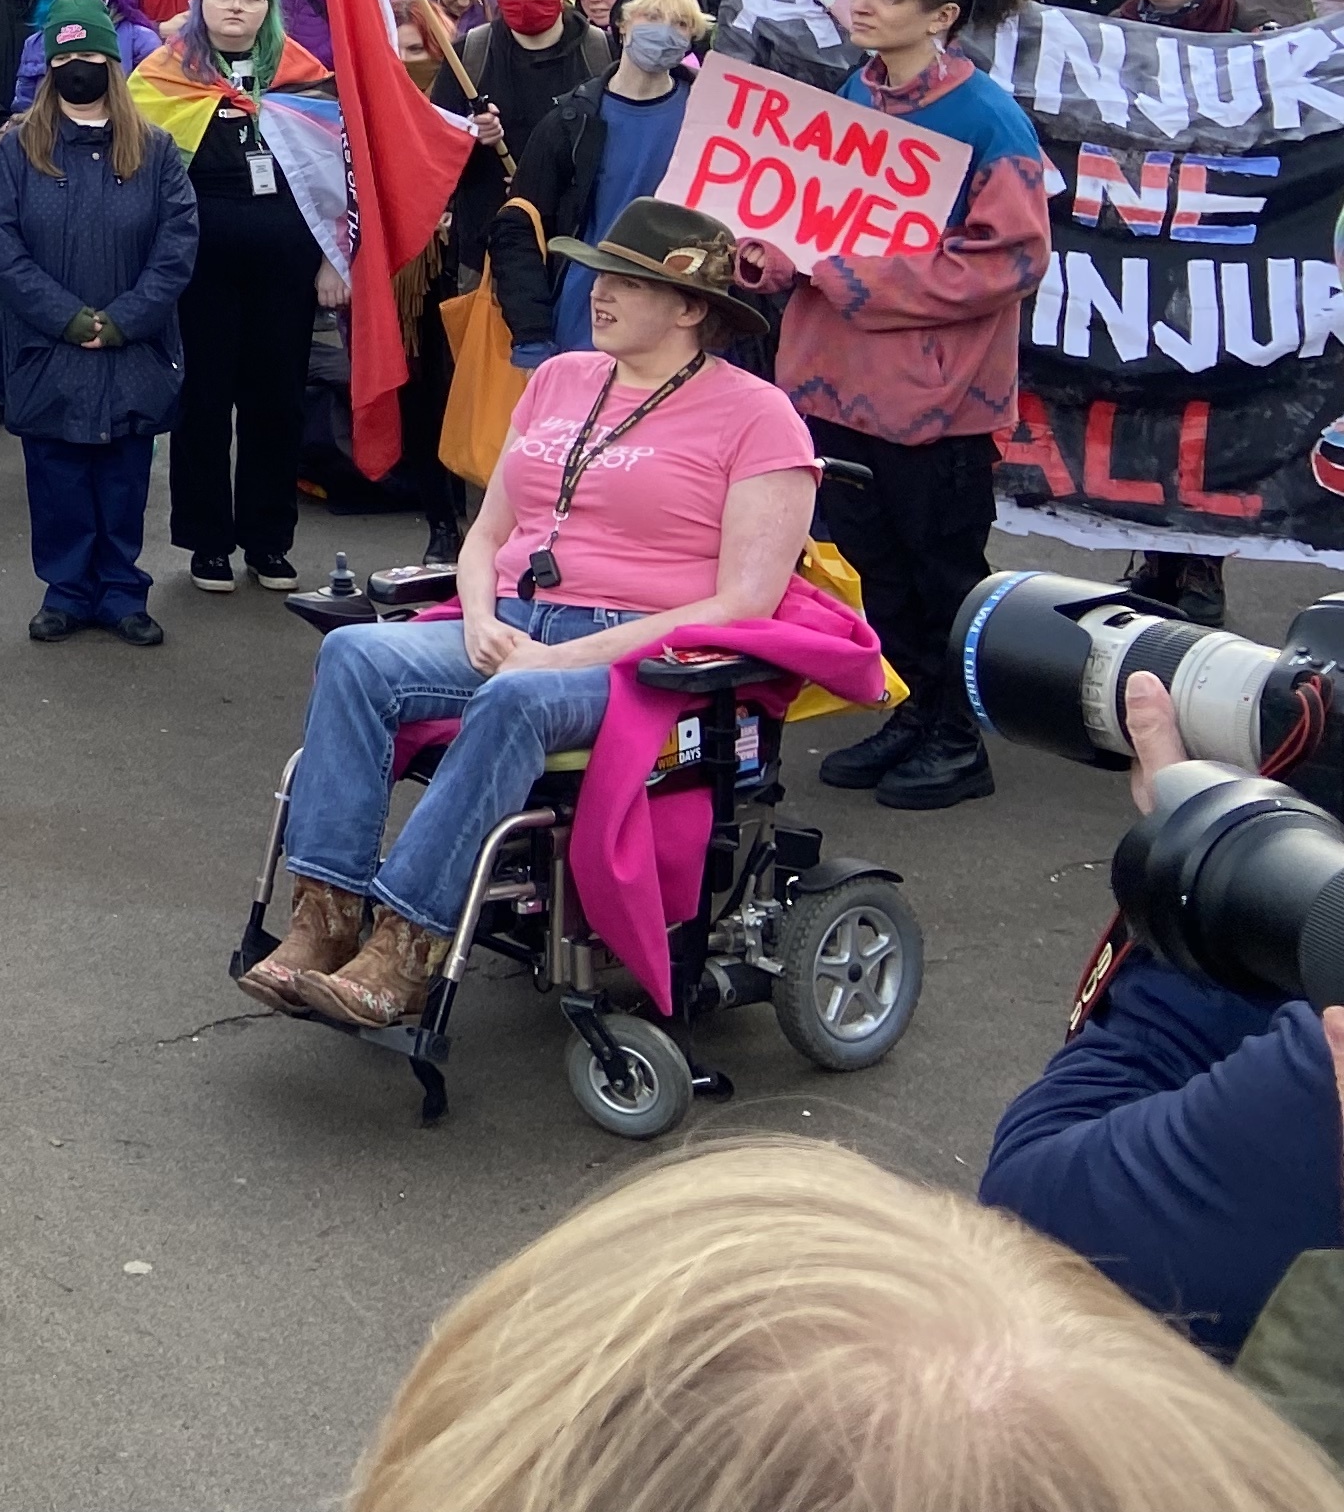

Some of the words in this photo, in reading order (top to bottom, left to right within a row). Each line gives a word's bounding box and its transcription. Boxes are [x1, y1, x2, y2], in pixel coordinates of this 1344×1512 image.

[723, 73, 940, 197] TRANS
[988, 9, 1344, 138] INJUR
[347, 170, 358, 203] OF
[1031, 250, 1344, 374] INJUR
[992, 391, 1262, 518] ALL
[679, 748, 701, 764] DAYS
